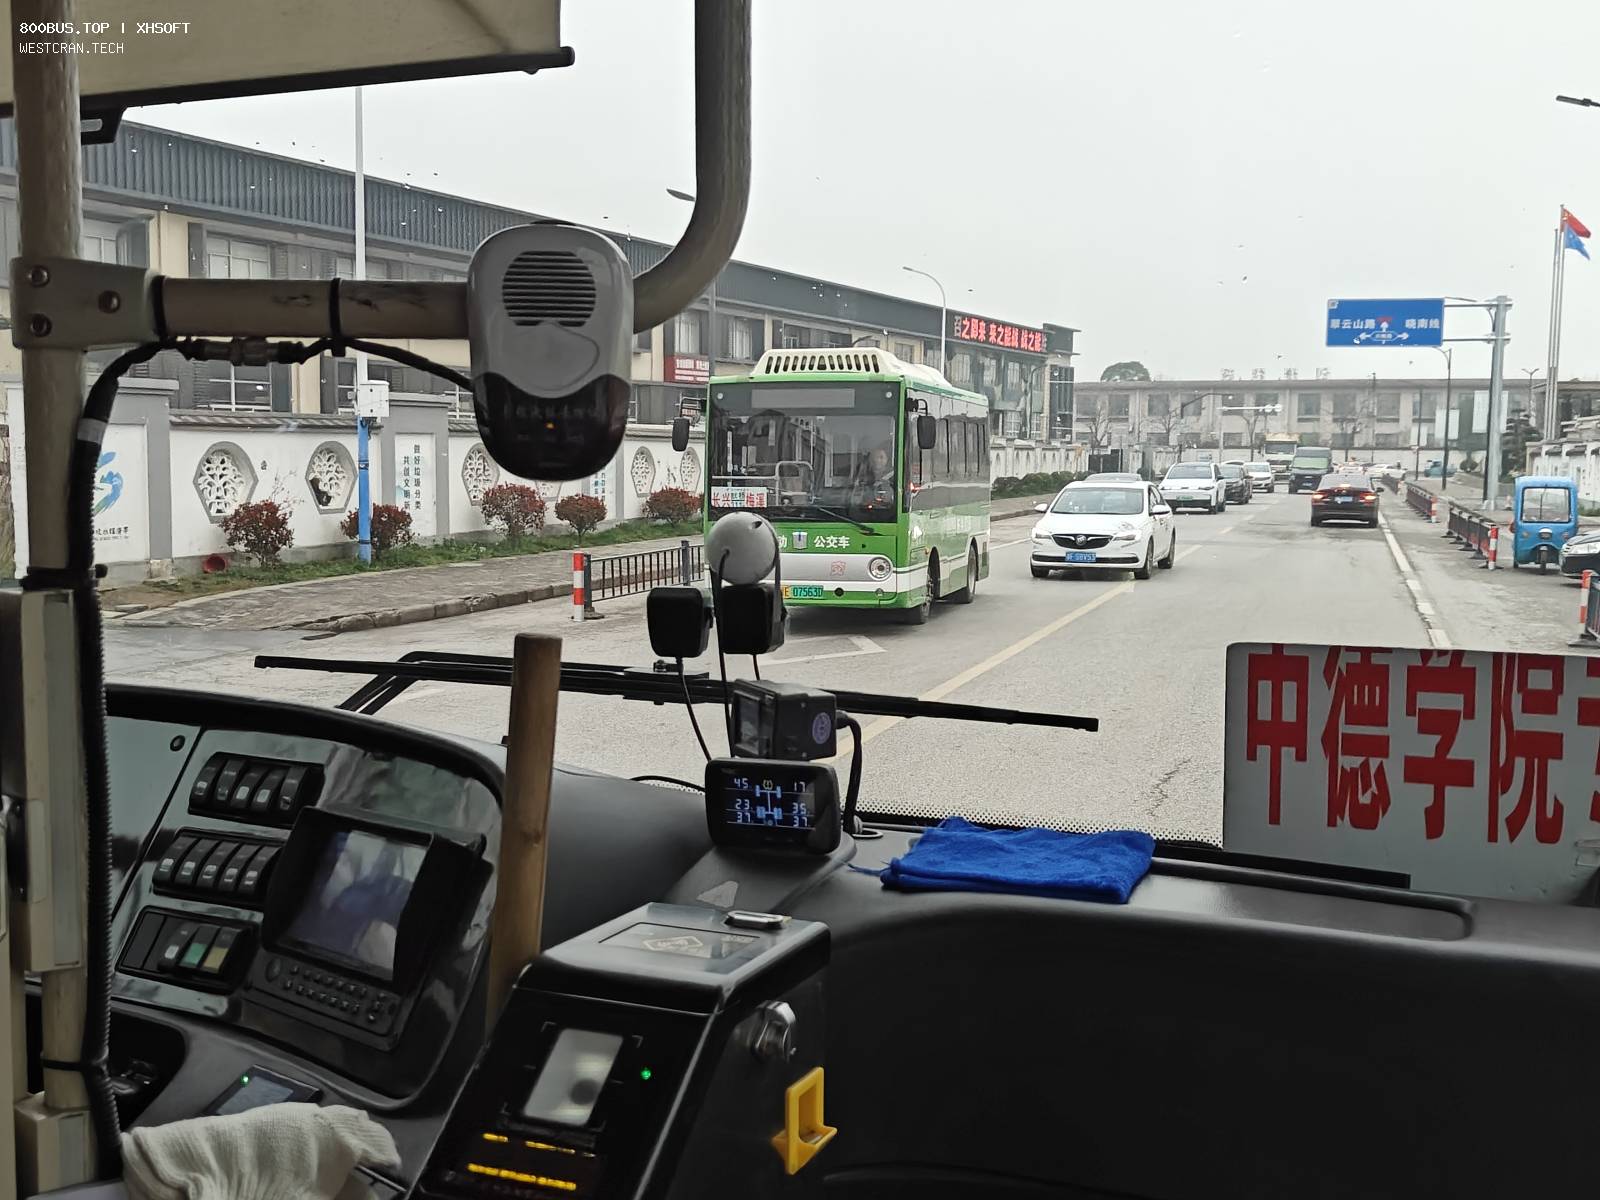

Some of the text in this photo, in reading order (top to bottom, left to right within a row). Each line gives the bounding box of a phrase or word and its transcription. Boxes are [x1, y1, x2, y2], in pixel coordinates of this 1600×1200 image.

[814, 535, 850, 549] 公交车
[734, 777, 749, 789] 45
[735, 798, 750, 810] 23
[792, 802, 807, 815] 35
[736, 811, 751, 823] 37
[793, 815, 808, 827] 37
